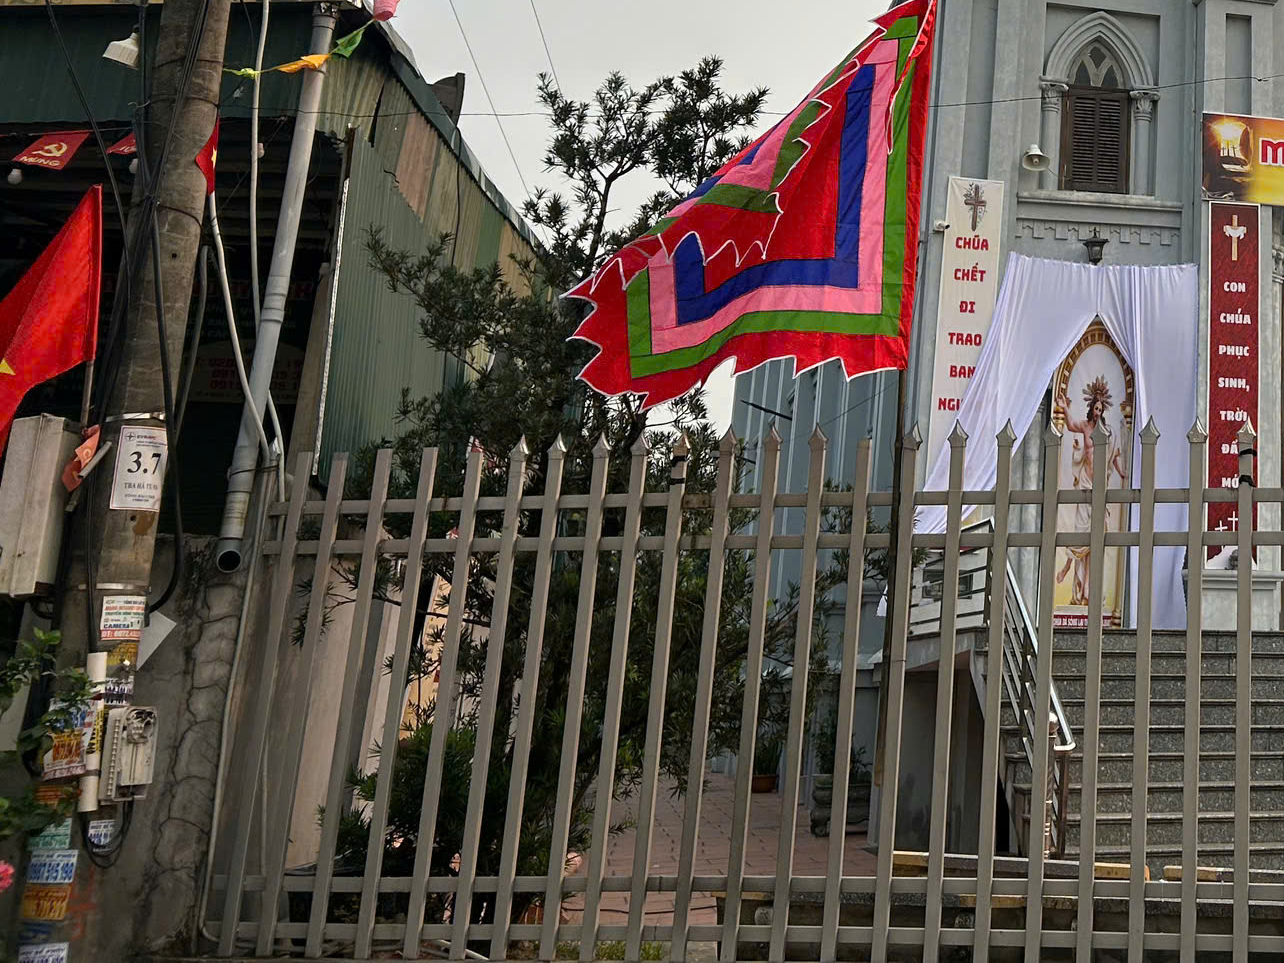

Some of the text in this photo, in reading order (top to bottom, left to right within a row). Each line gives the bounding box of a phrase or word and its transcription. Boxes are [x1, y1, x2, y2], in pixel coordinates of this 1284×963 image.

[955, 235, 989, 251] CHÚA
[954, 262, 986, 282] CHẾT
[1223, 281, 1246, 292] CON
[959, 300, 976, 314] ĐI
[1219, 308, 1251, 325] CHÚA
[948, 332, 982, 346] TRAO
[1218, 344, 1250, 359] PHỤC
[1218, 377, 1250, 392] SINH,
[1219, 407, 1247, 422] TRỜI
[1221, 439, 1239, 454] ĐẤ
[127, 451, 162, 475] 3.7
